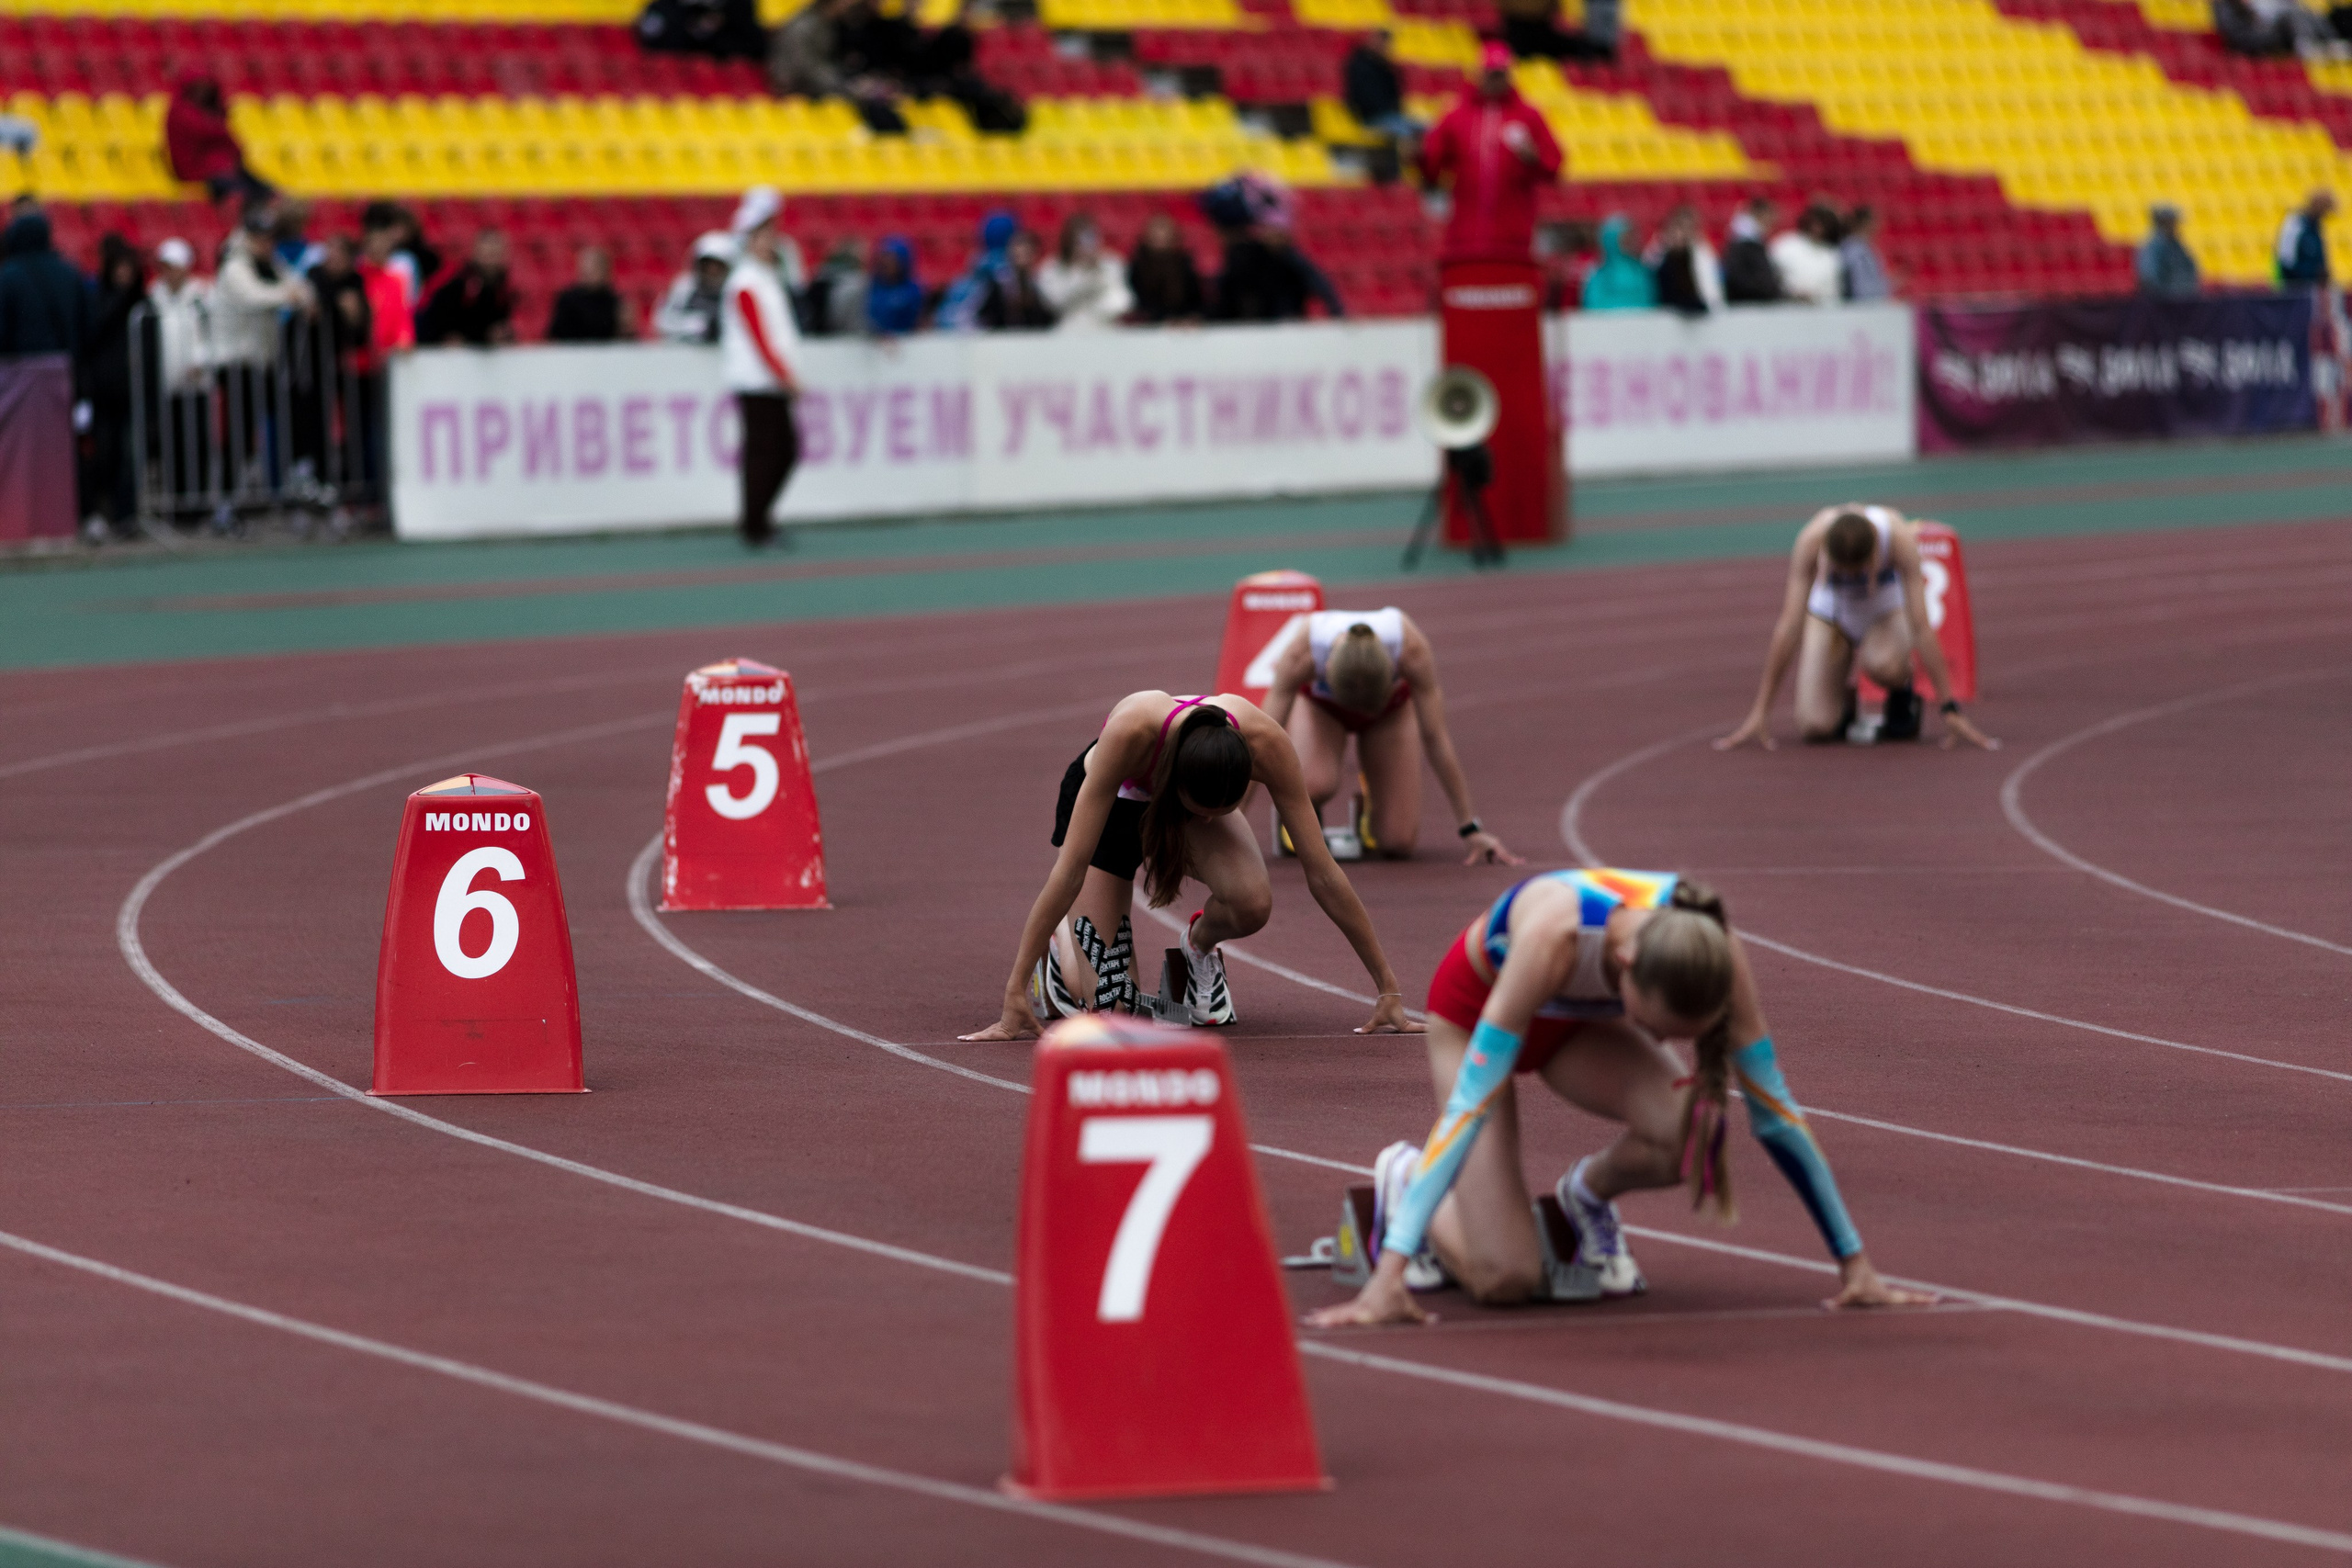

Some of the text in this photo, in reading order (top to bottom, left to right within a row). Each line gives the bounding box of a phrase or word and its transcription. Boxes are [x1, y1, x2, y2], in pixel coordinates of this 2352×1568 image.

[420, 384, 975, 483] ПРИВЕТСВУЕМ
[699, 687, 784, 705] MONDO
[705, 712, 781, 820] 5
[425, 812, 530, 831] MONDO
[434, 846, 526, 979] 6
[1068, 1069, 1220, 1107] MONDO
[1079, 1115, 1215, 1323] 7
